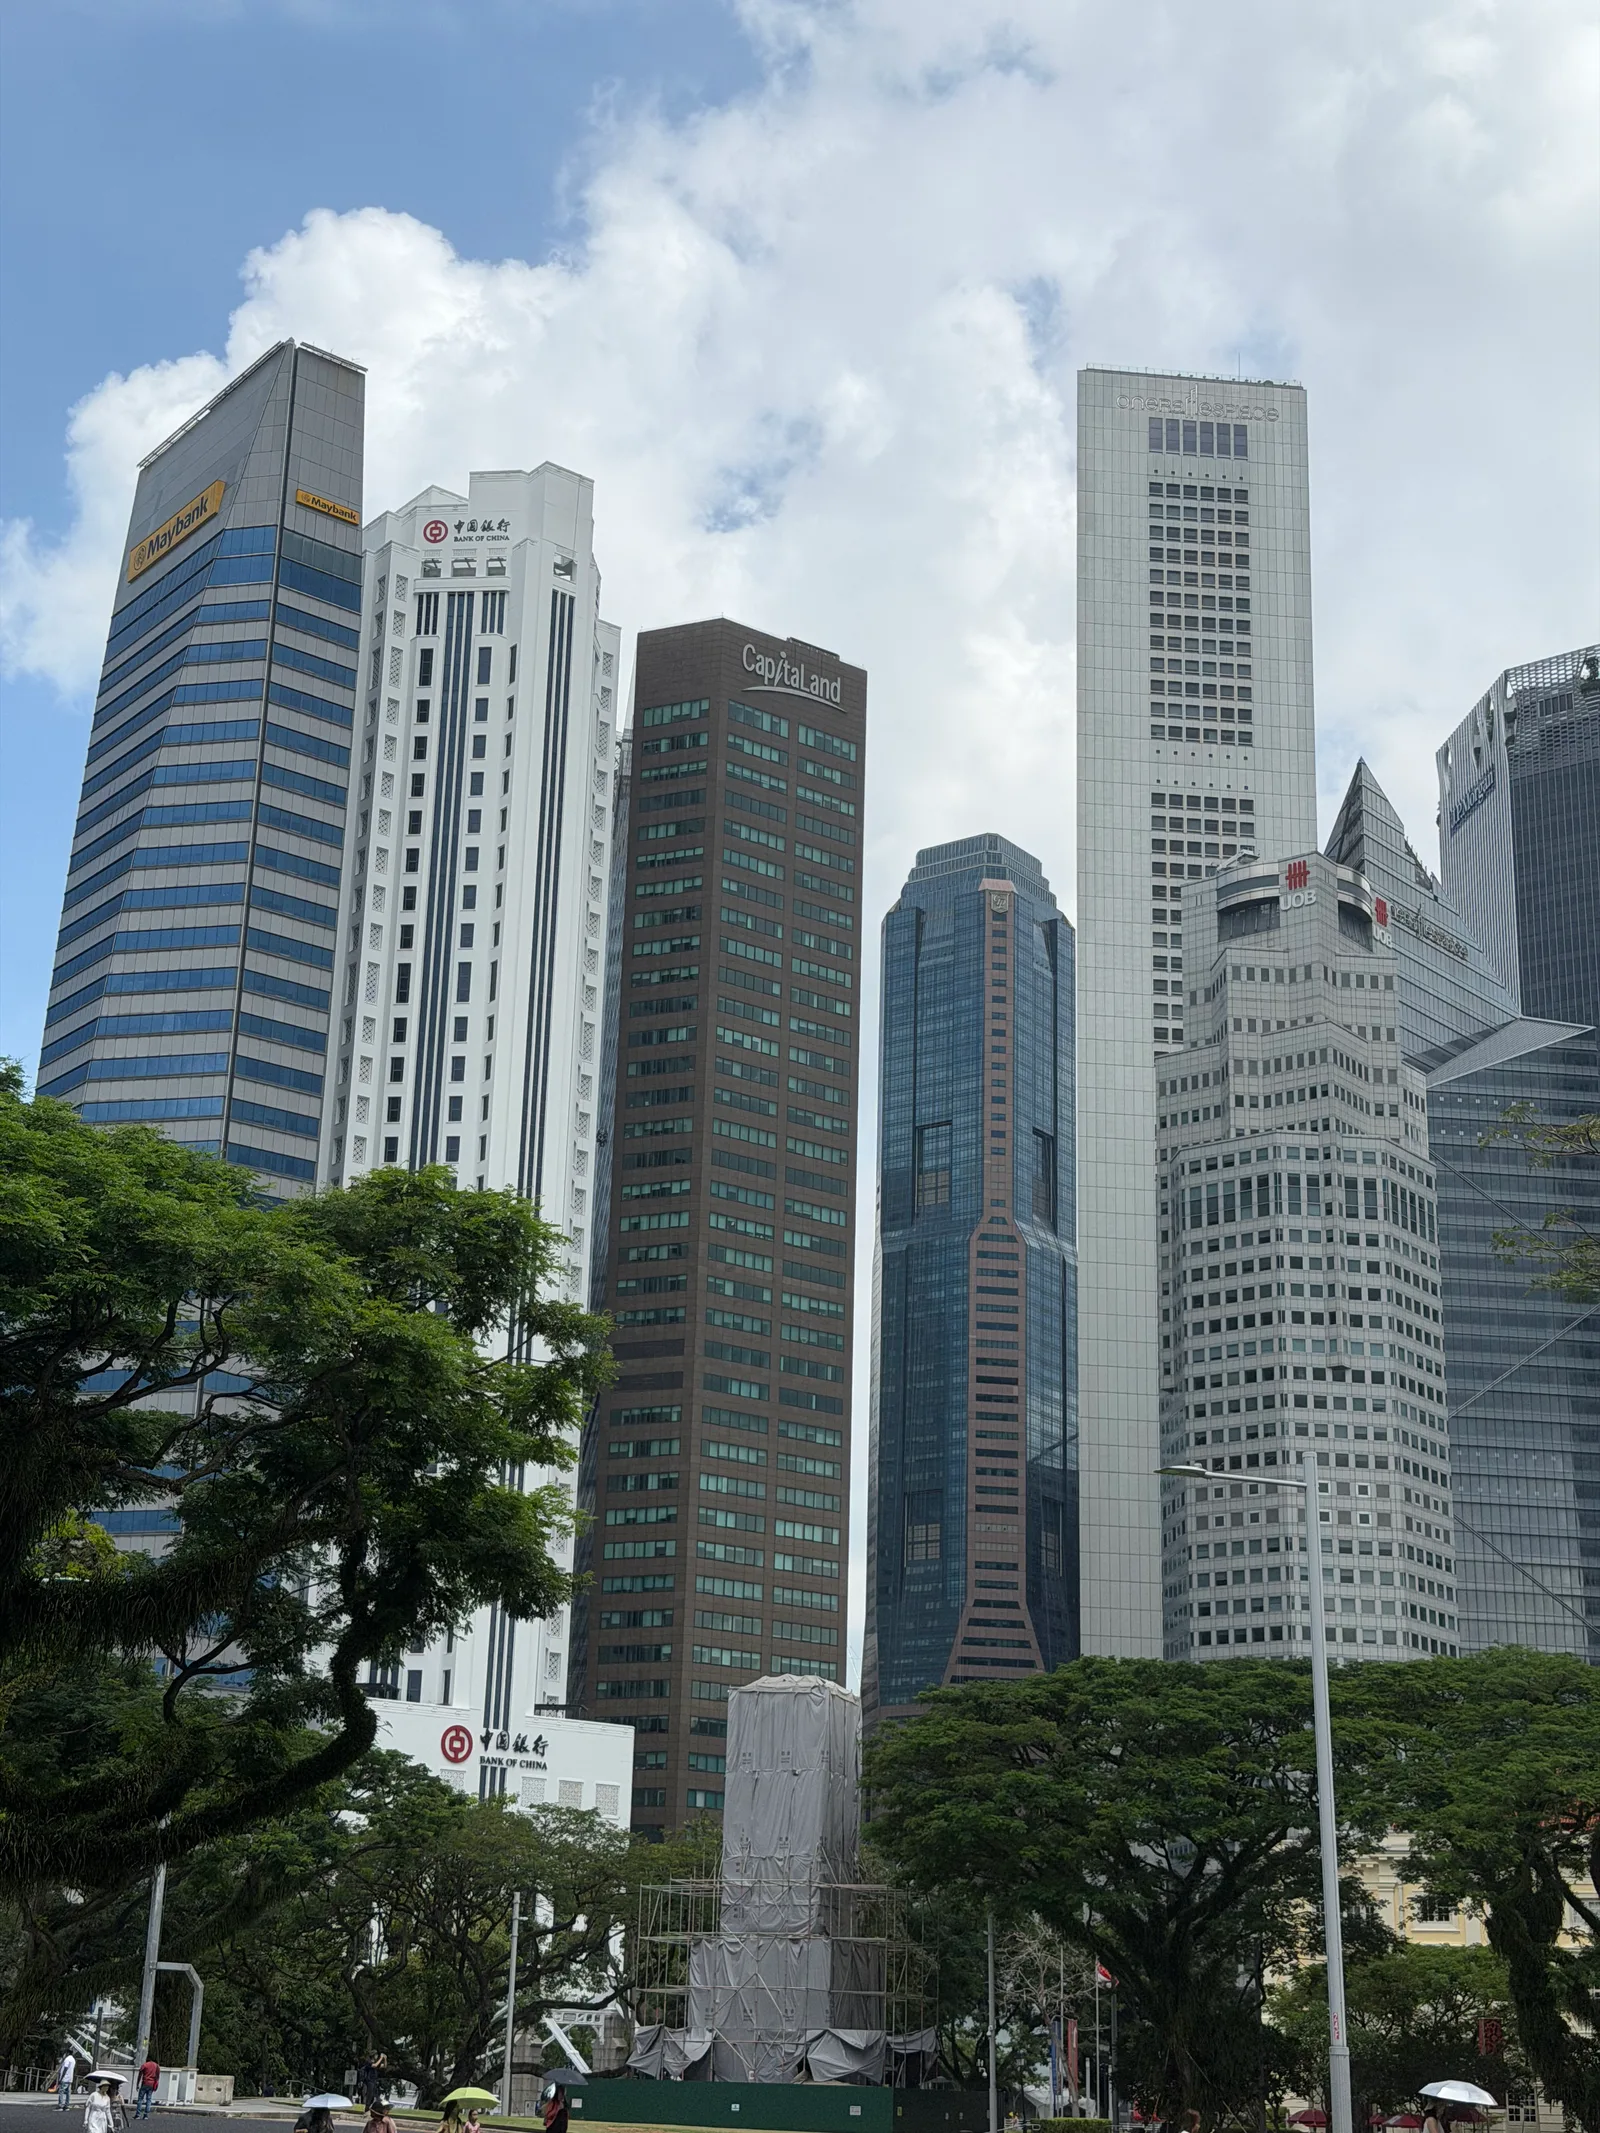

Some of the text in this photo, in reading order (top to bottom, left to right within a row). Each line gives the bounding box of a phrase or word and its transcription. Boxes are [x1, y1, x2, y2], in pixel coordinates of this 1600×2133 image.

[311, 496, 357, 522] Maybank
[147, 496, 209, 560] Maybank
[742, 643, 841, 704] CapitaLand
[1280, 889, 1317, 911] UOB
[1373, 924, 1393, 949] UOB
[479, 1755, 548, 1771] BANK OF CHINA
